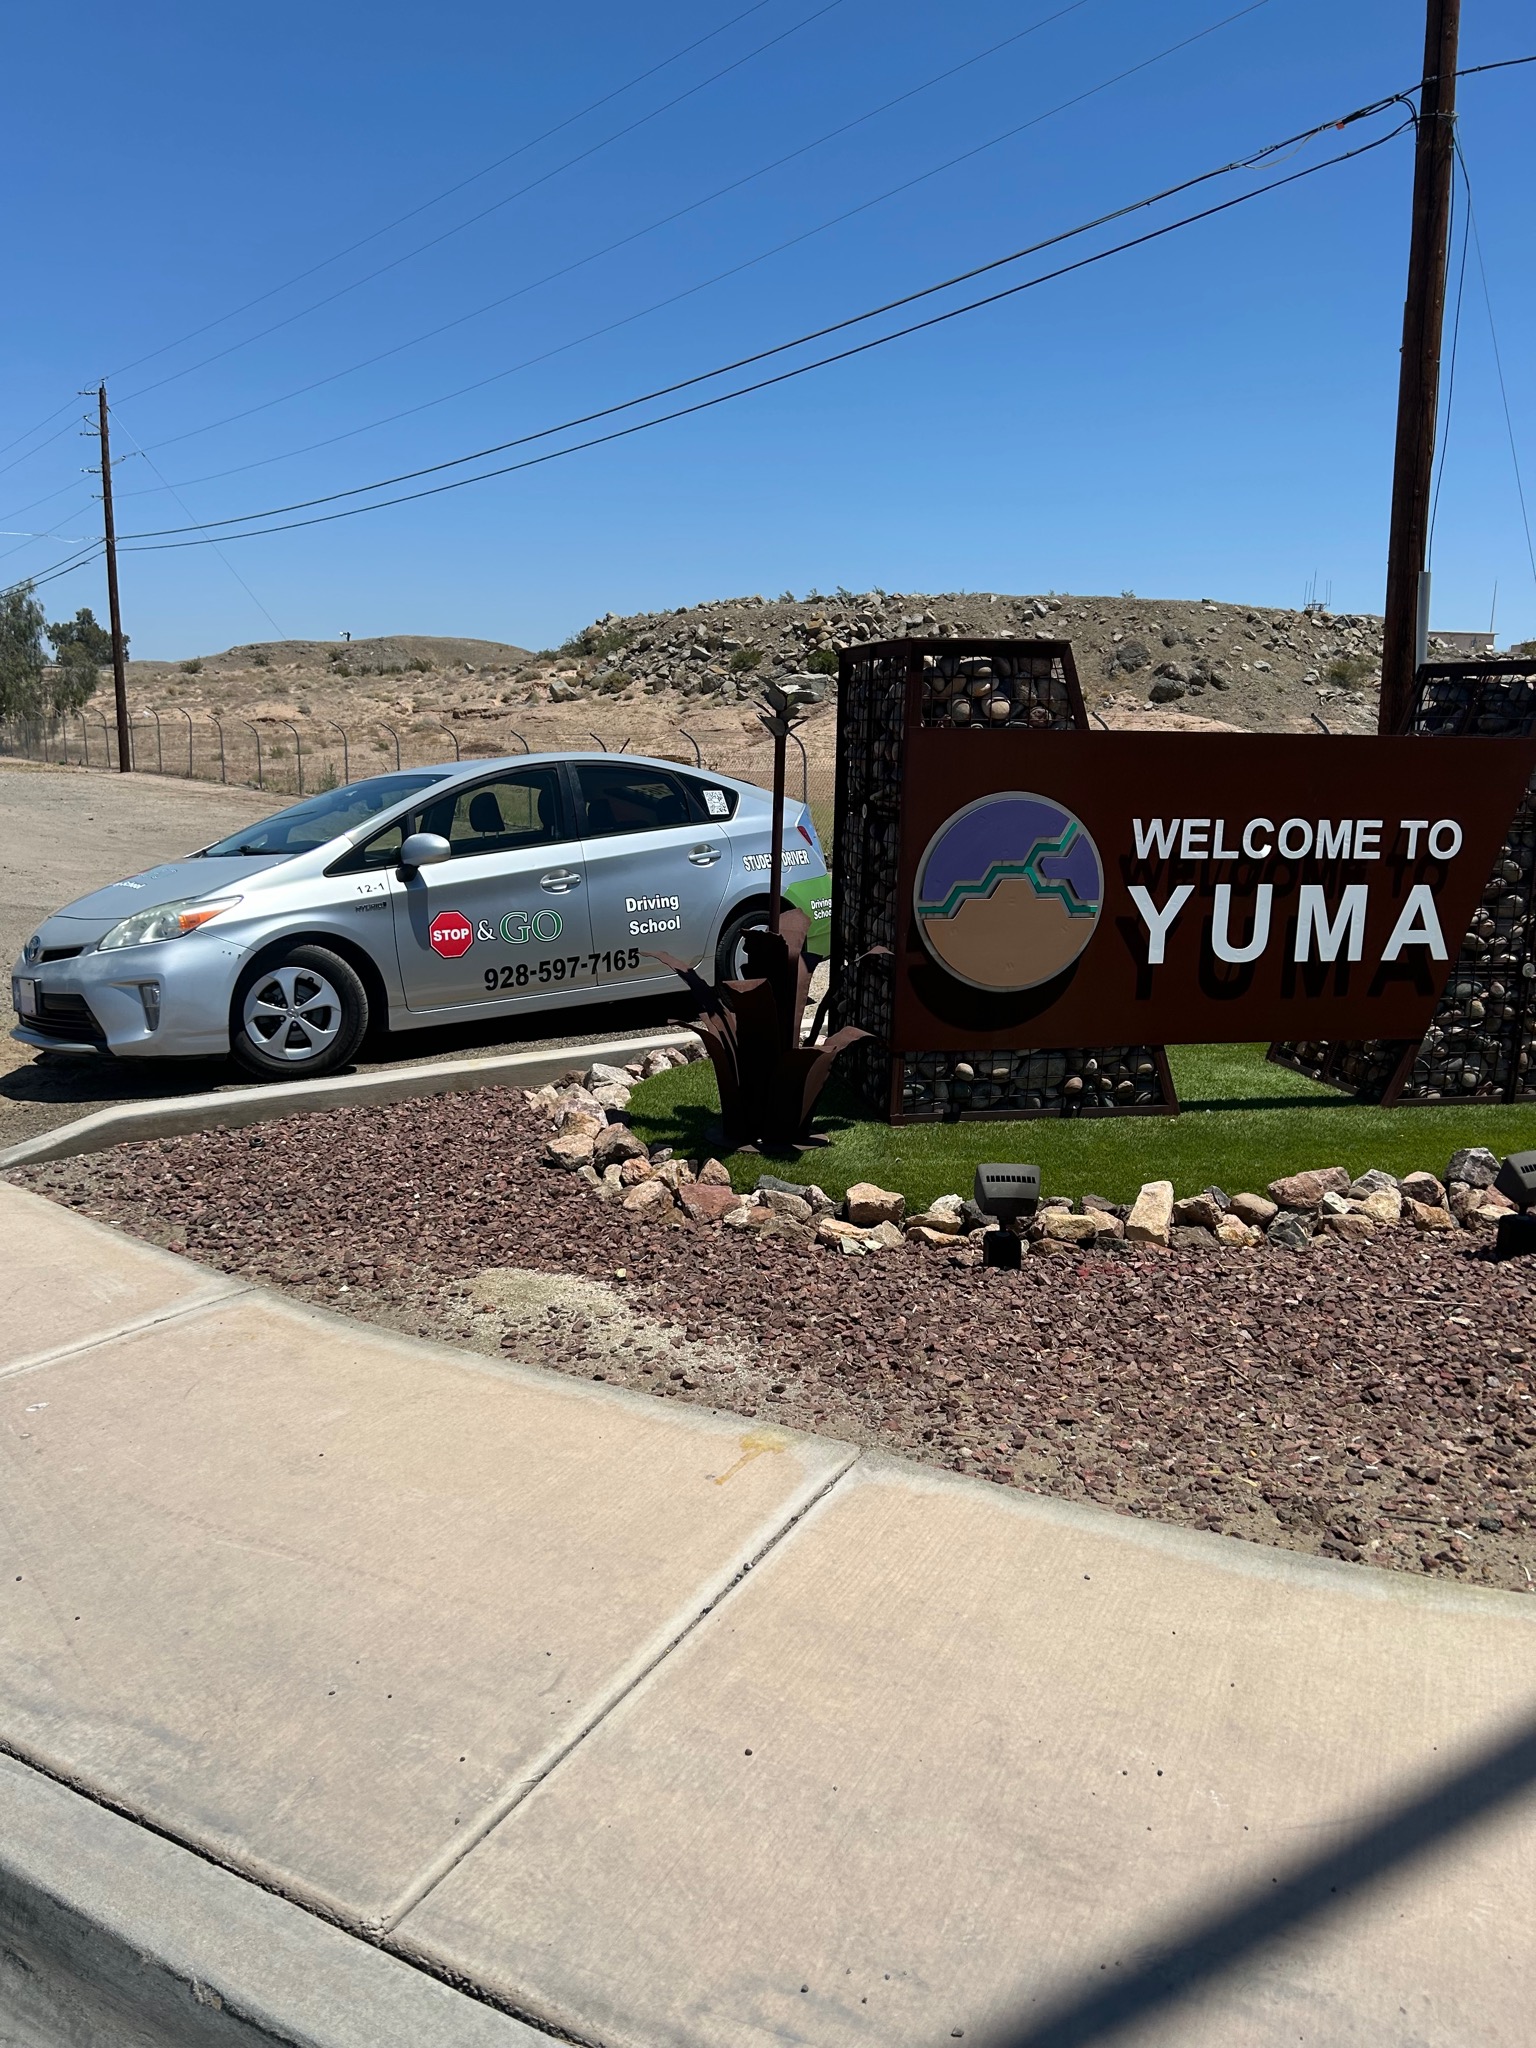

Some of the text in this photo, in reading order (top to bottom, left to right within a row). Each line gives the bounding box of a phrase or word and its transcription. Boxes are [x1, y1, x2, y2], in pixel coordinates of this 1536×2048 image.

[1132, 817, 1463, 860] WELCOME TO
[742, 849, 810, 872] STUDE DRIVER
[356, 882, 385, 894] 12-1
[625, 894, 680, 913] Driving
[811, 898, 832, 910] Driving
[813, 909, 832, 920] Schoo
[433, 909, 564, 945] STOP & GO
[629, 915, 682, 936] School
[1127, 883, 1449, 964] YUMA
[483, 947, 641, 992] 928-597-7165
